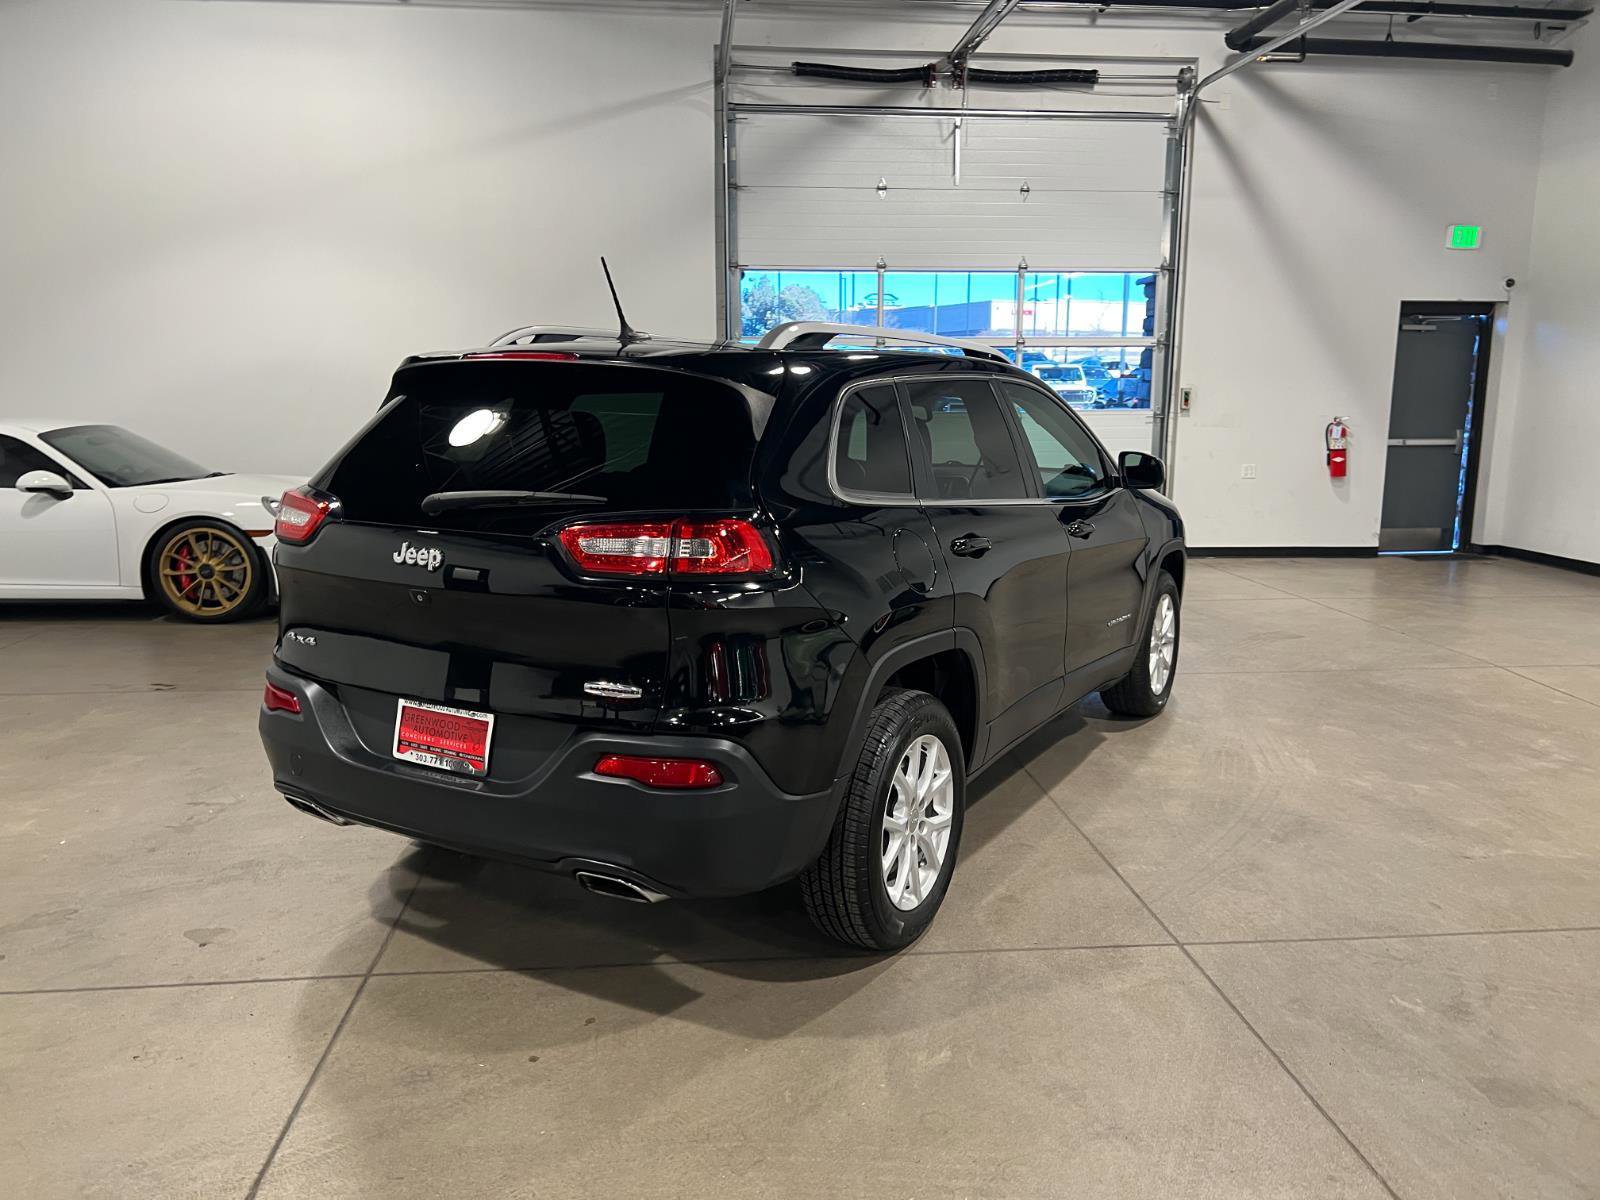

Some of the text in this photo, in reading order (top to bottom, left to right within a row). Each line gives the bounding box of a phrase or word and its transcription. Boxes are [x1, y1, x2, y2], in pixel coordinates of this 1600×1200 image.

[392, 541, 442, 571] Jeep
[404, 712, 461, 731] GREENWOOD
[401, 731, 467, 750] CONCIERGE SERVICES
[412, 725, 468, 743] AUTOMOTIVE
